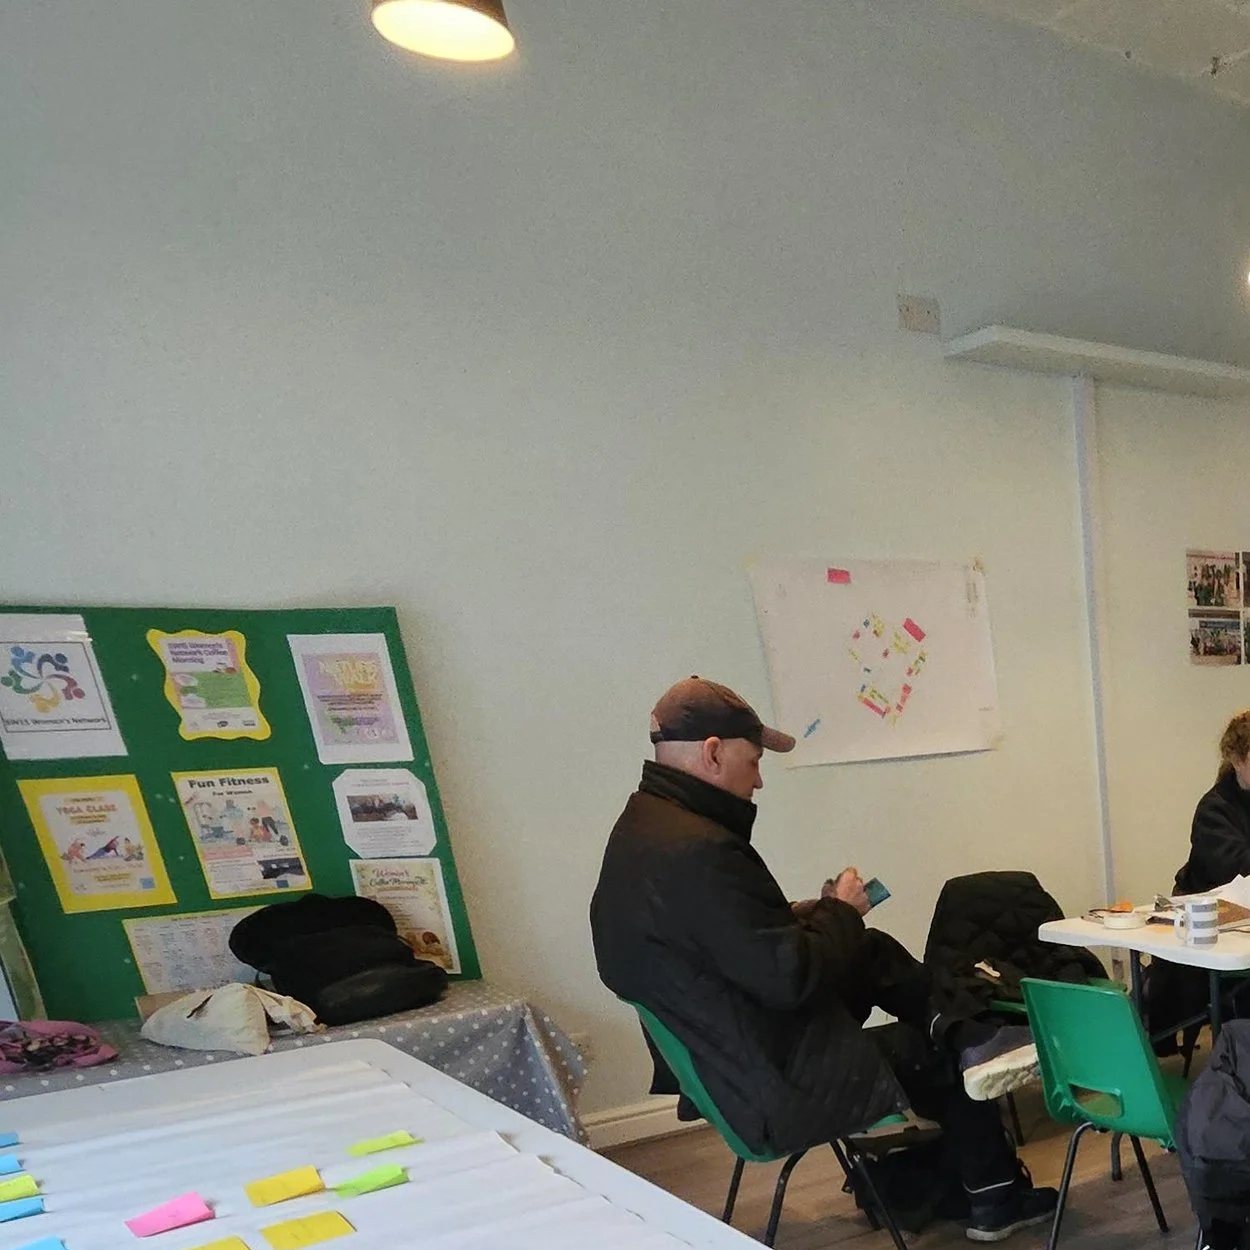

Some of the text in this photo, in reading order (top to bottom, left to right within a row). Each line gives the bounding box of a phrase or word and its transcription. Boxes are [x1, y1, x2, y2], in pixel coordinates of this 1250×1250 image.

[188, 776, 270, 789] Fun Fitness
[56, 803, 119, 815] YOGA CLASS
